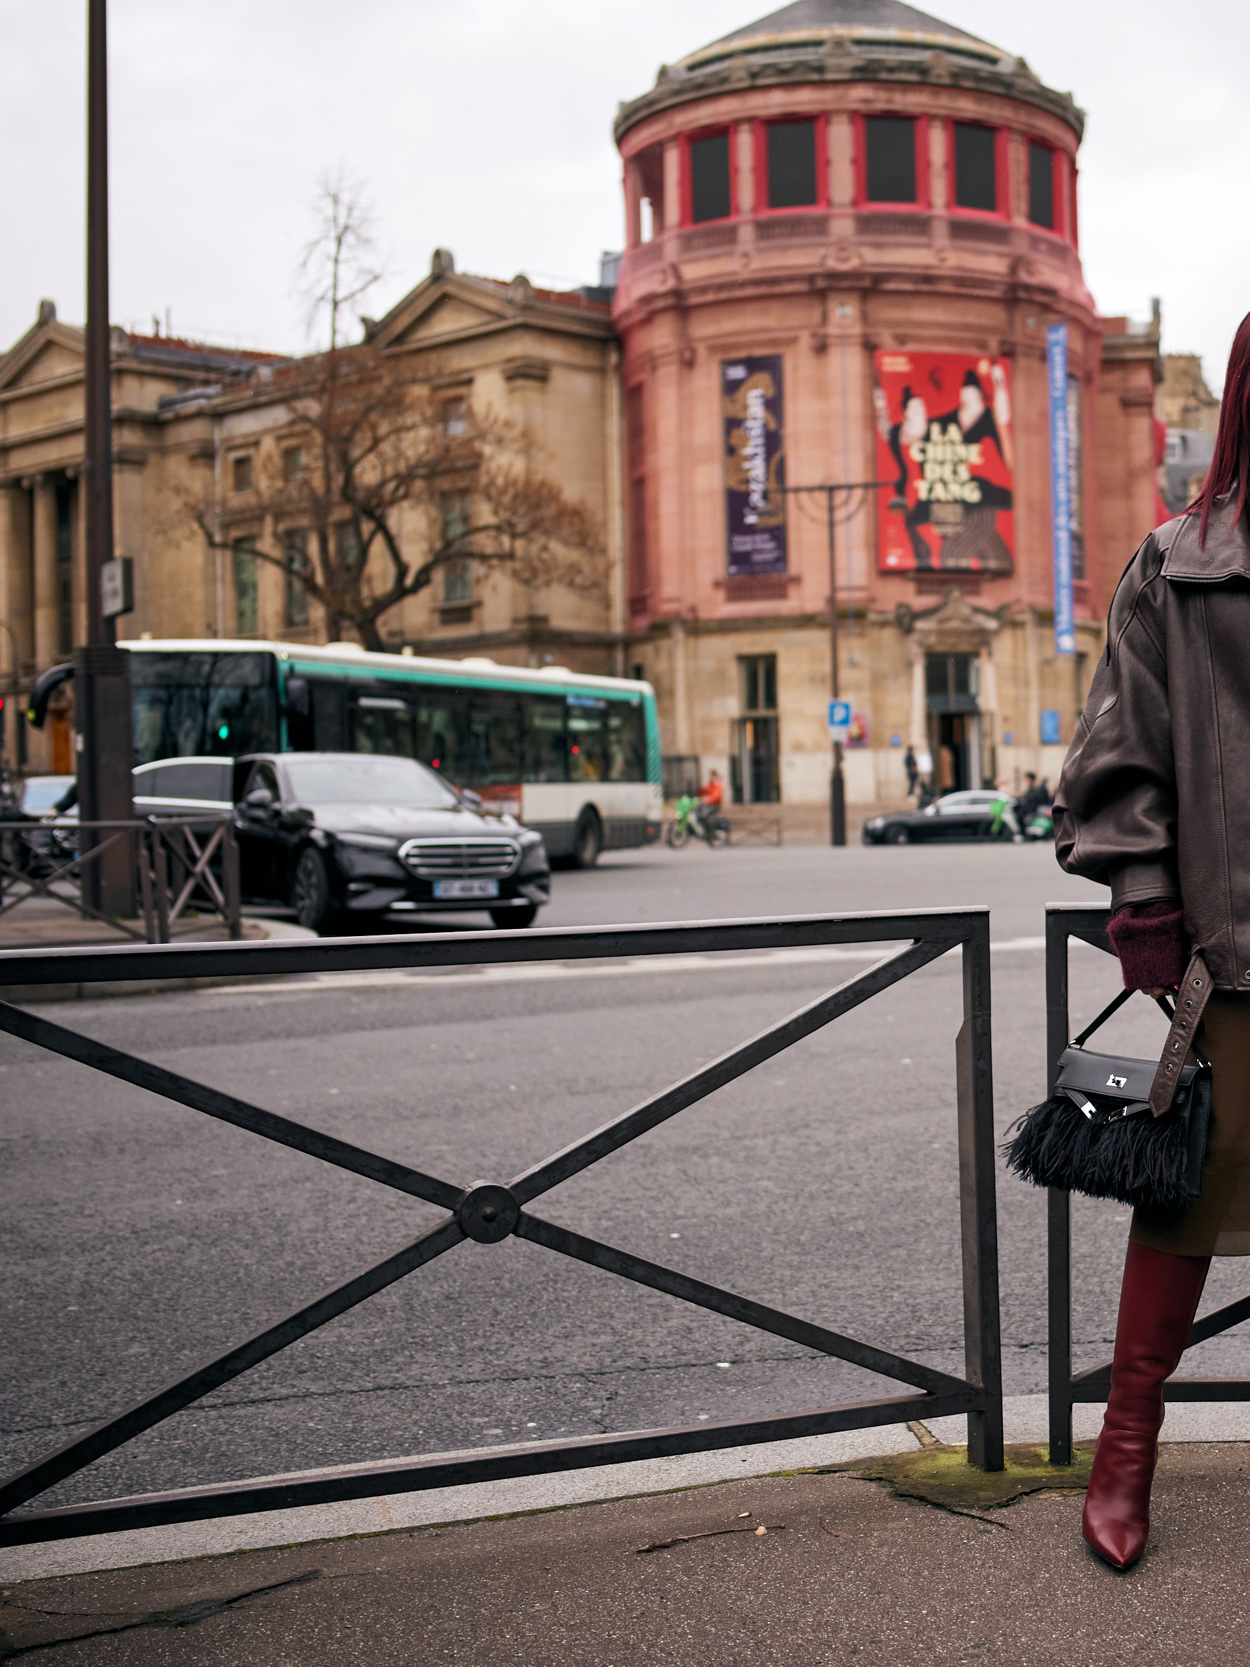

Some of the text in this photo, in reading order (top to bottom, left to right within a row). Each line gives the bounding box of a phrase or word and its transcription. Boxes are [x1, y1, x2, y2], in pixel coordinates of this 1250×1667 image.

[929, 421, 963, 442] LA
[909, 440, 984, 465] CHINE
[924, 460, 971, 482] DES
[913, 479, 982, 503] TANG
